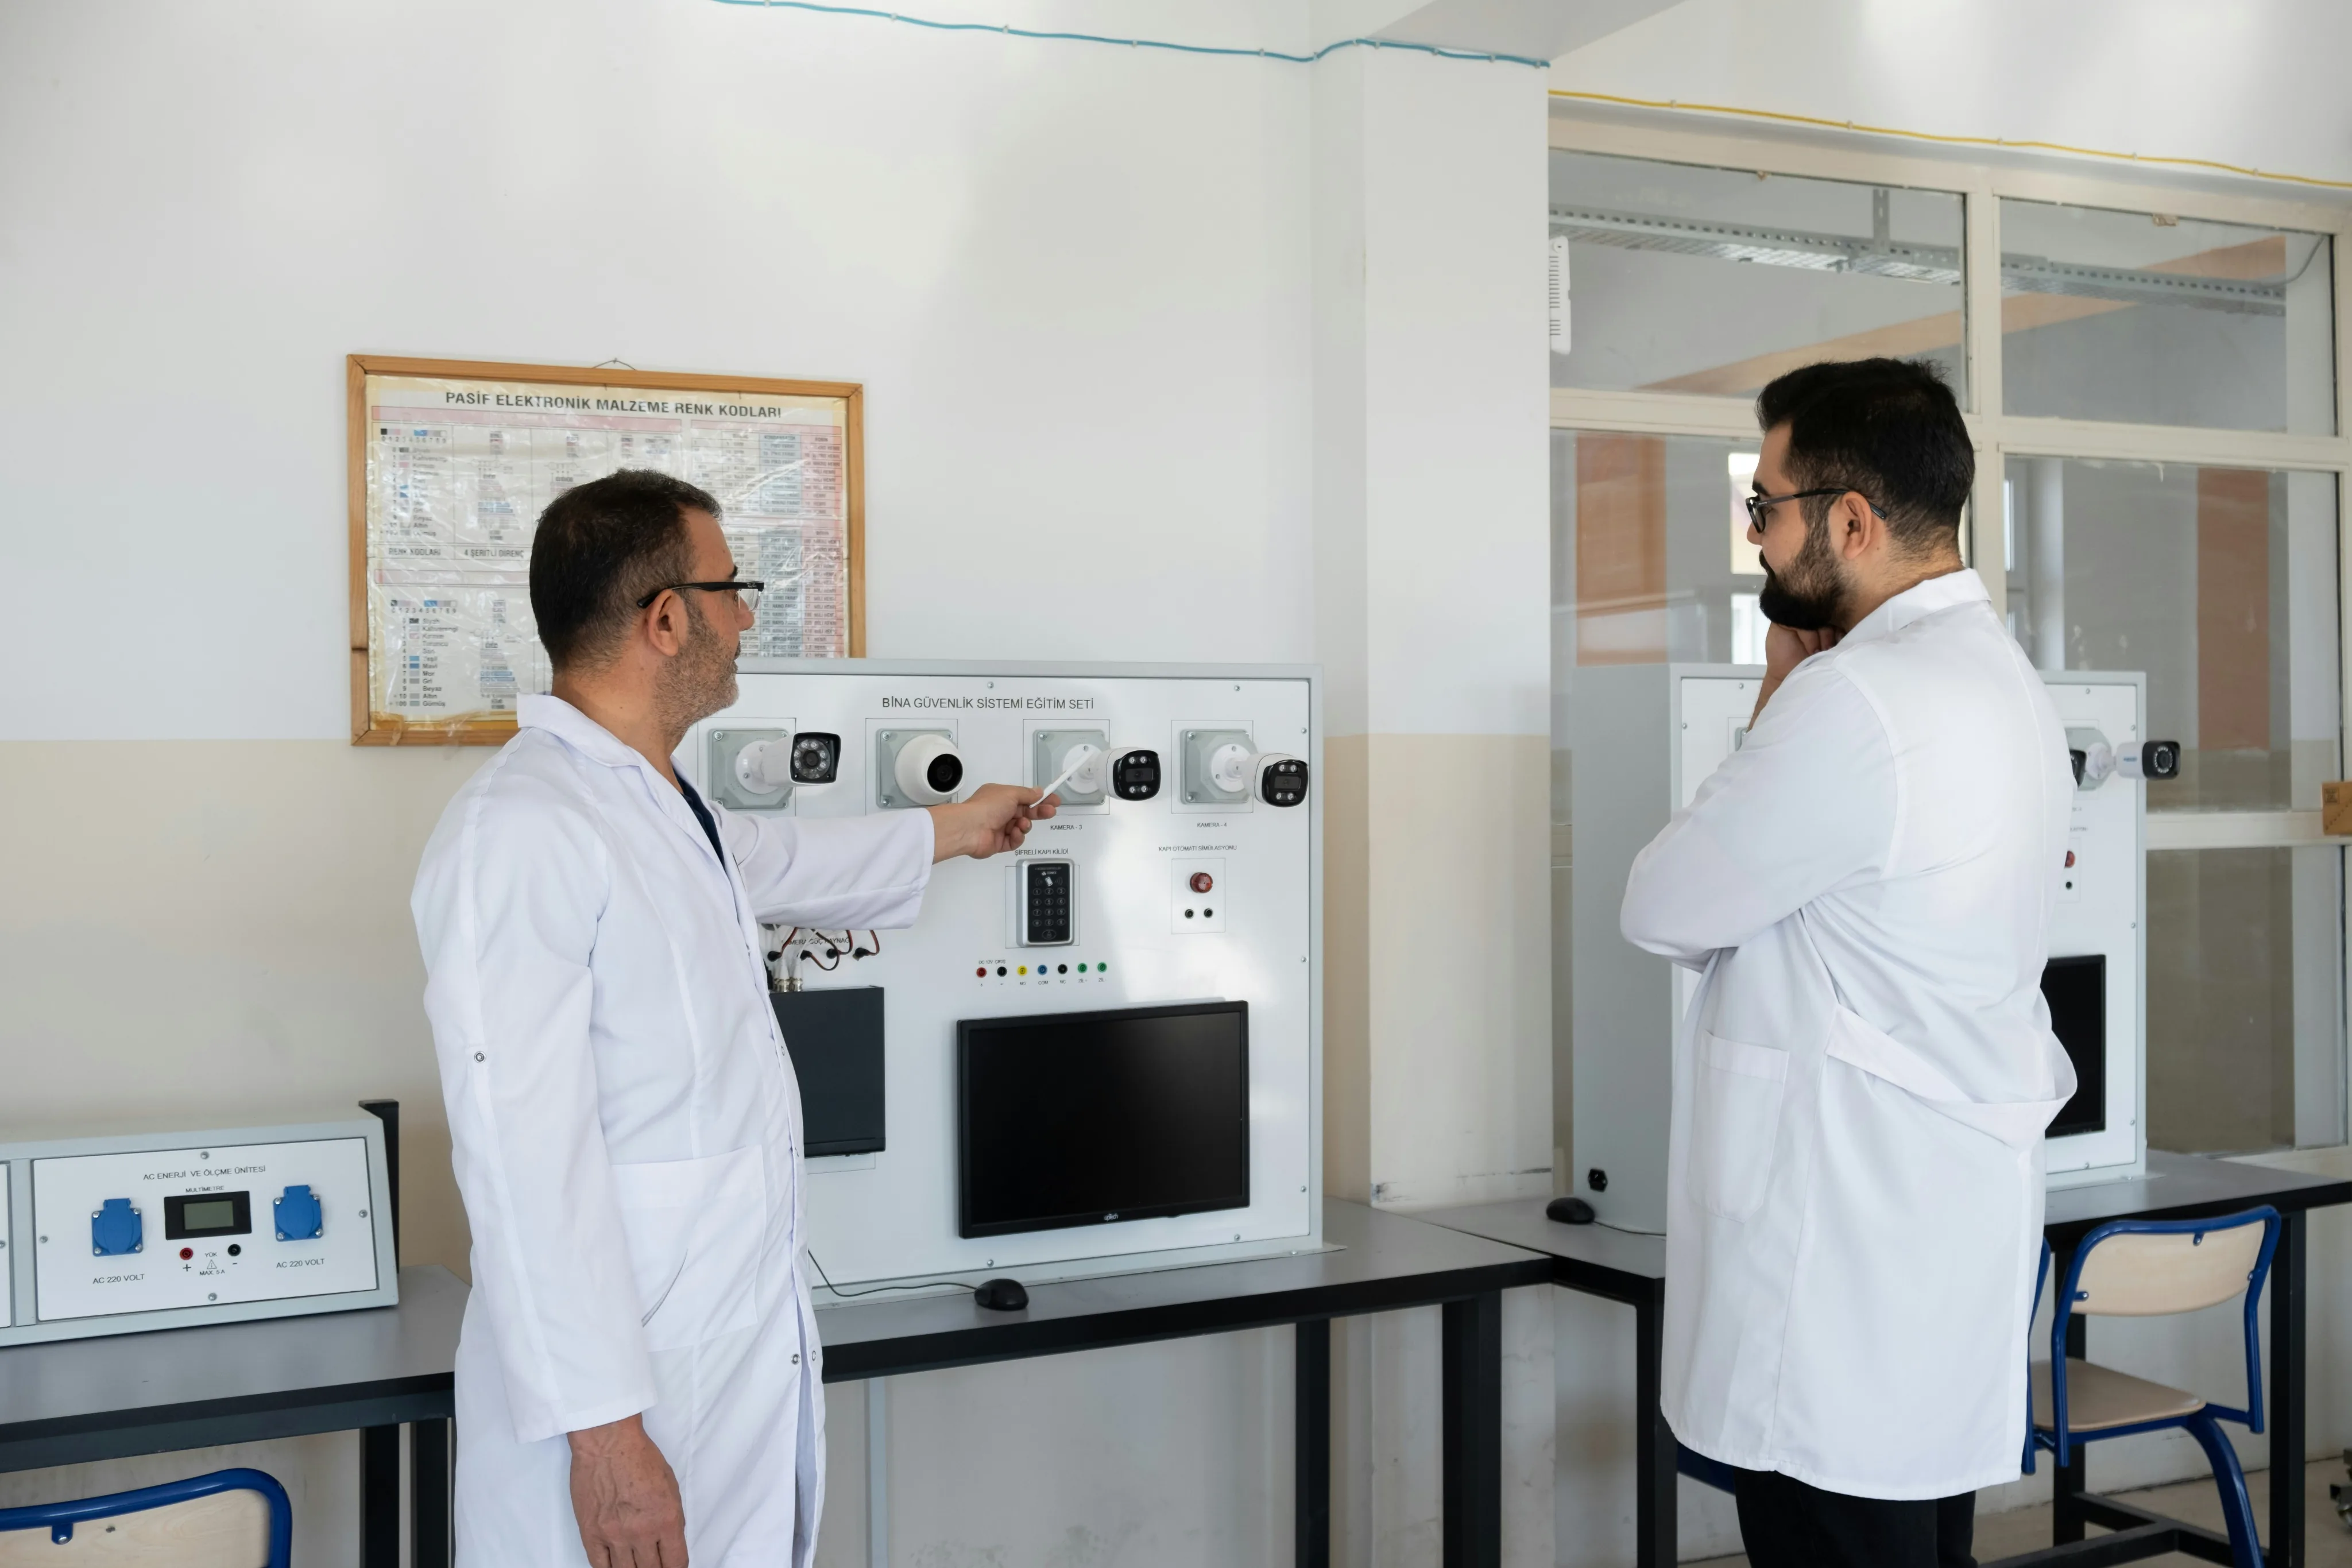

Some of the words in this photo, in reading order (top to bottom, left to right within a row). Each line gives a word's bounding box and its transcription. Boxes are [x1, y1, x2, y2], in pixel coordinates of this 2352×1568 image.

[446, 391, 490, 405] PASİF
[496, 394, 590, 409] ELEKTRONİK
[597, 399, 669, 413] MALZEME
[675, 403, 713, 415] RENK
[719, 405, 781, 418] KODLARI
[882, 696, 911, 708] BİNA
[914, 696, 973, 708] GÜVENLİK
[977, 696, 1023, 709] SİSTEMİ
[1027, 697, 1065, 709] EĞİTİM
[1069, 698, 1093, 709] SETİ
[157, 1170, 186, 1180] ENERJİ
[203, 1168, 232, 1177] ÖLÇME
[234, 1165, 266, 1174] ÜNİTESİ
[304, 1258, 325, 1266] VOLT
[107, 1275, 121, 1283] 220
